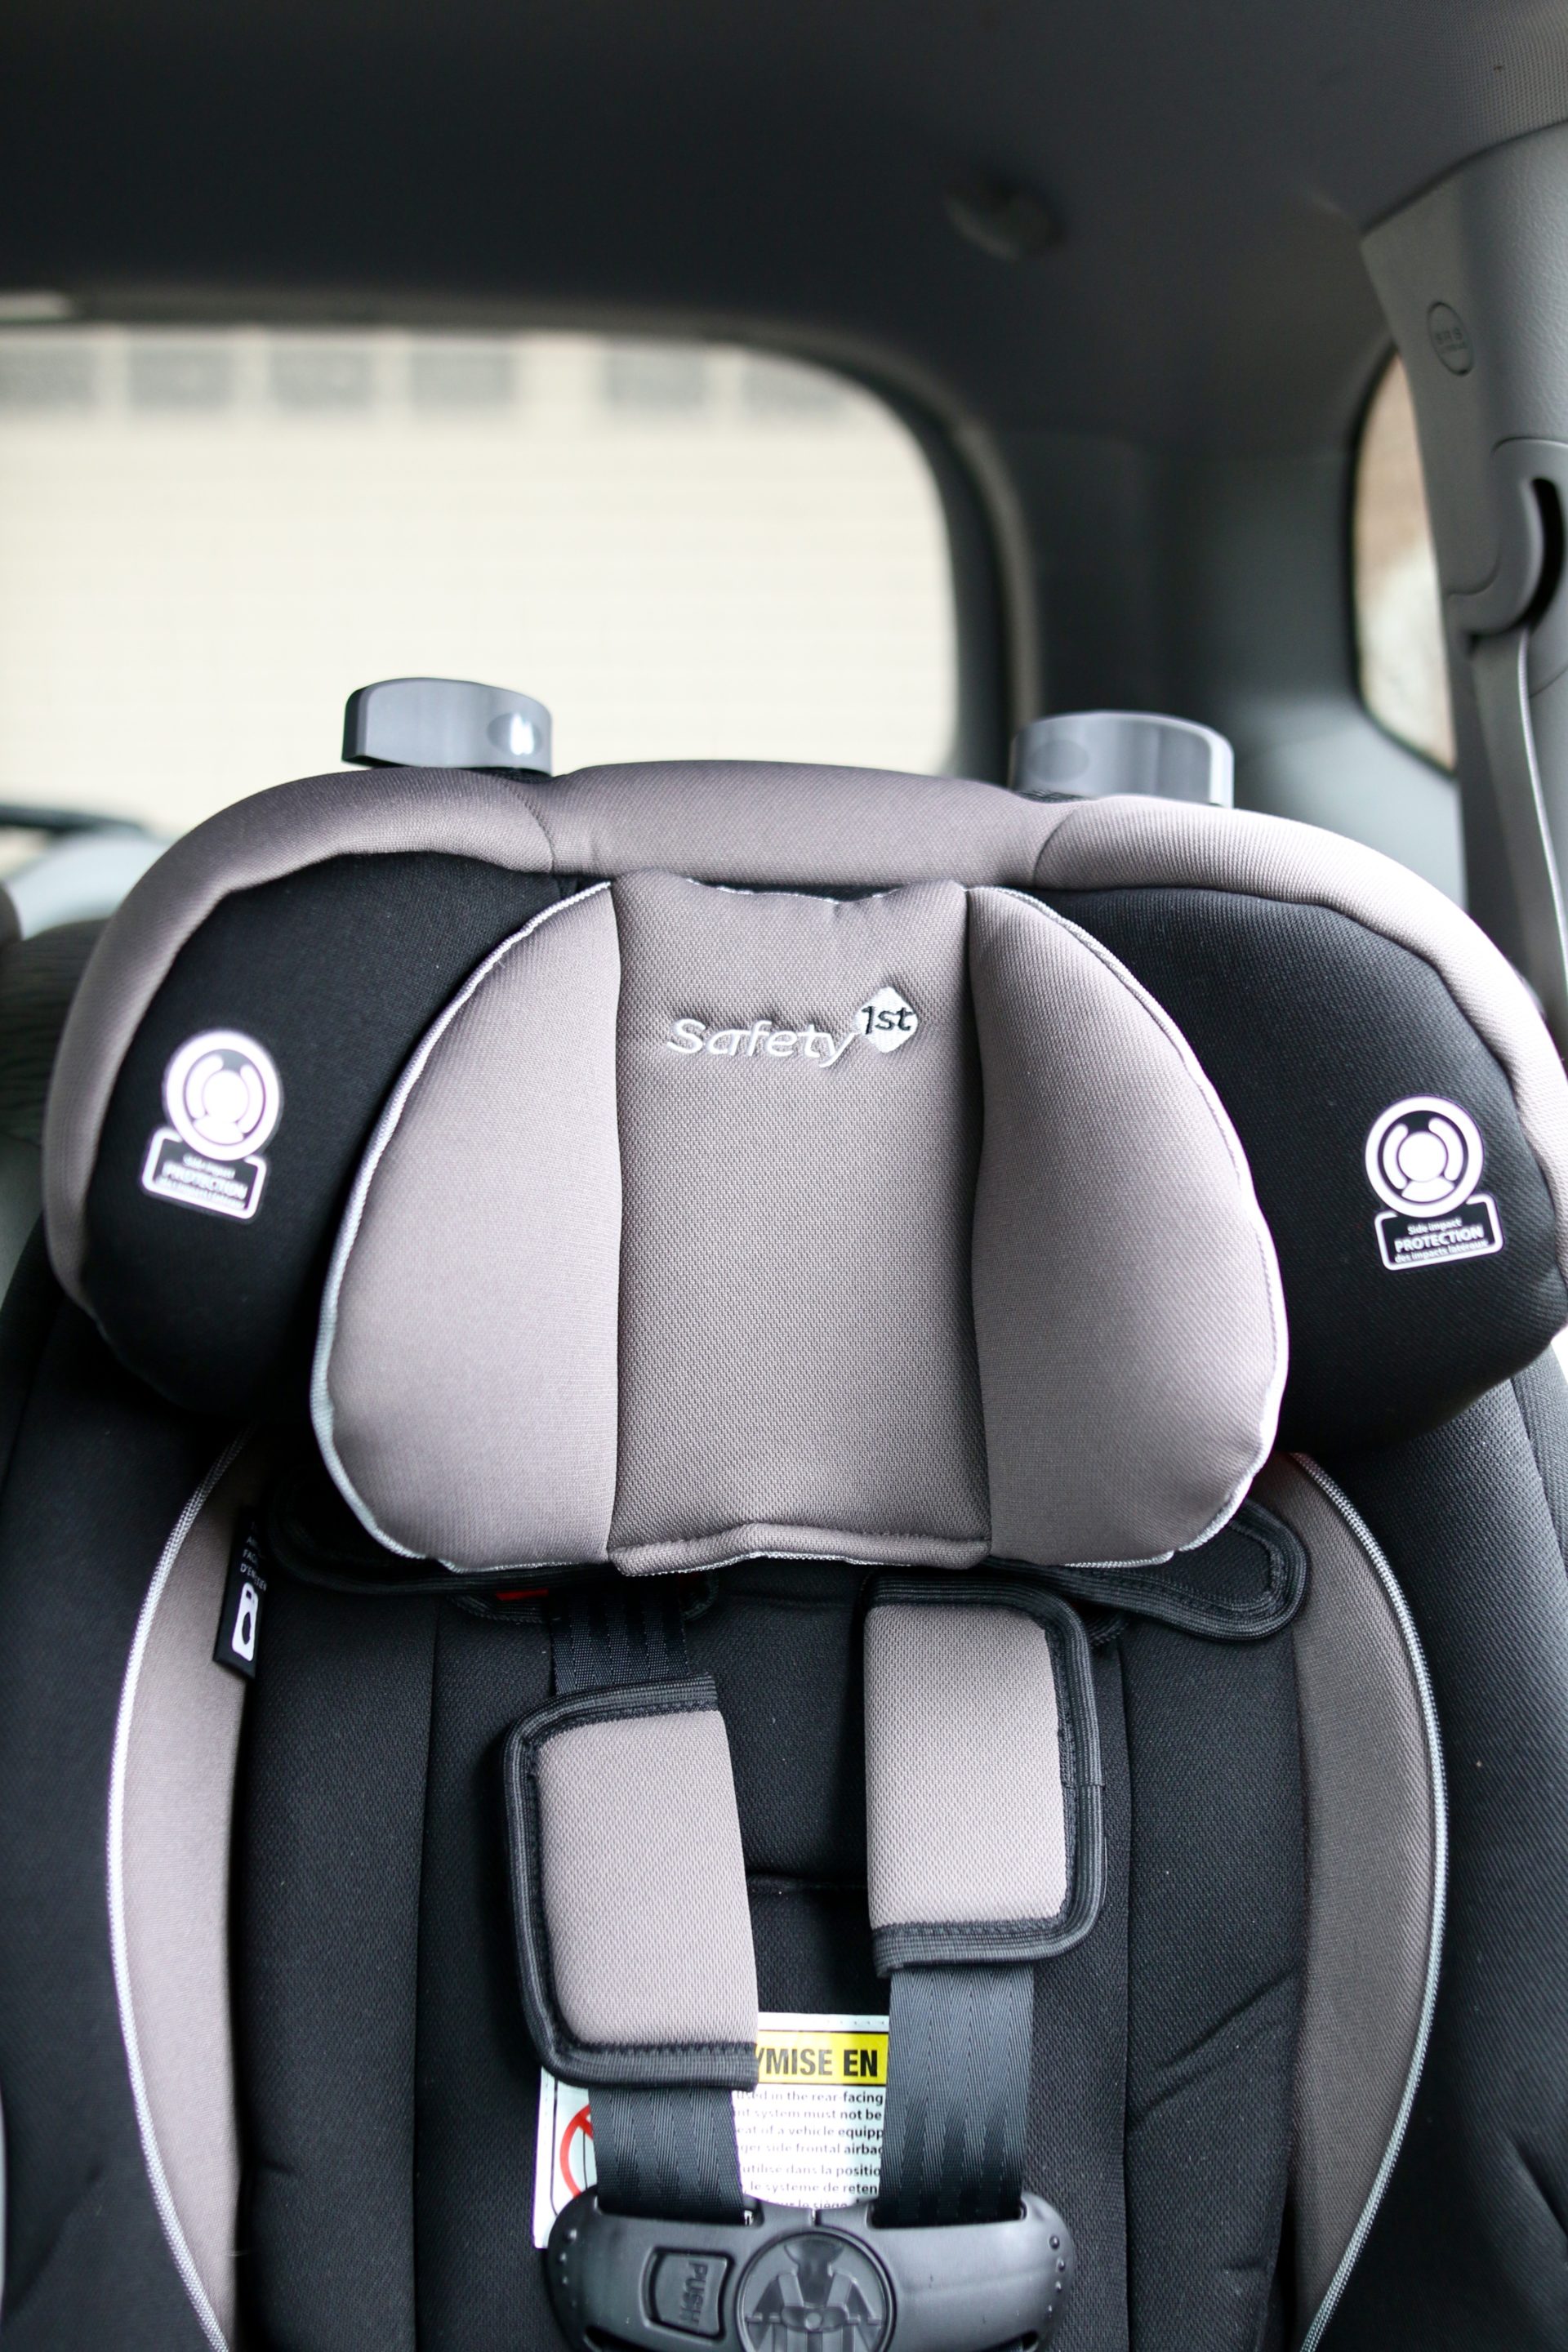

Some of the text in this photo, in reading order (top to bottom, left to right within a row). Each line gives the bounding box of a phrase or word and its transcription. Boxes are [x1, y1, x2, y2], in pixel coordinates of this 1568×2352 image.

[666, 1005, 914, 1067] Safety 1st
[1407, 1218, 1463, 1235] Side impact
[1394, 1227, 1485, 1253] PROTECTION
[844, 2049, 878, 2077] EN
[787, 2091, 807, 2101] the
[804, 2109, 835, 2119] must
[840, 2109, 862, 2120] not
[866, 2109, 882, 2120] be
[789, 2125, 834, 2136] vehicle
[796, 2143, 840, 2154] frontal
[822, 2164, 832, 2175] la
[823, 2182, 840, 2192] de
[679, 2261, 708, 2326] PUSH
